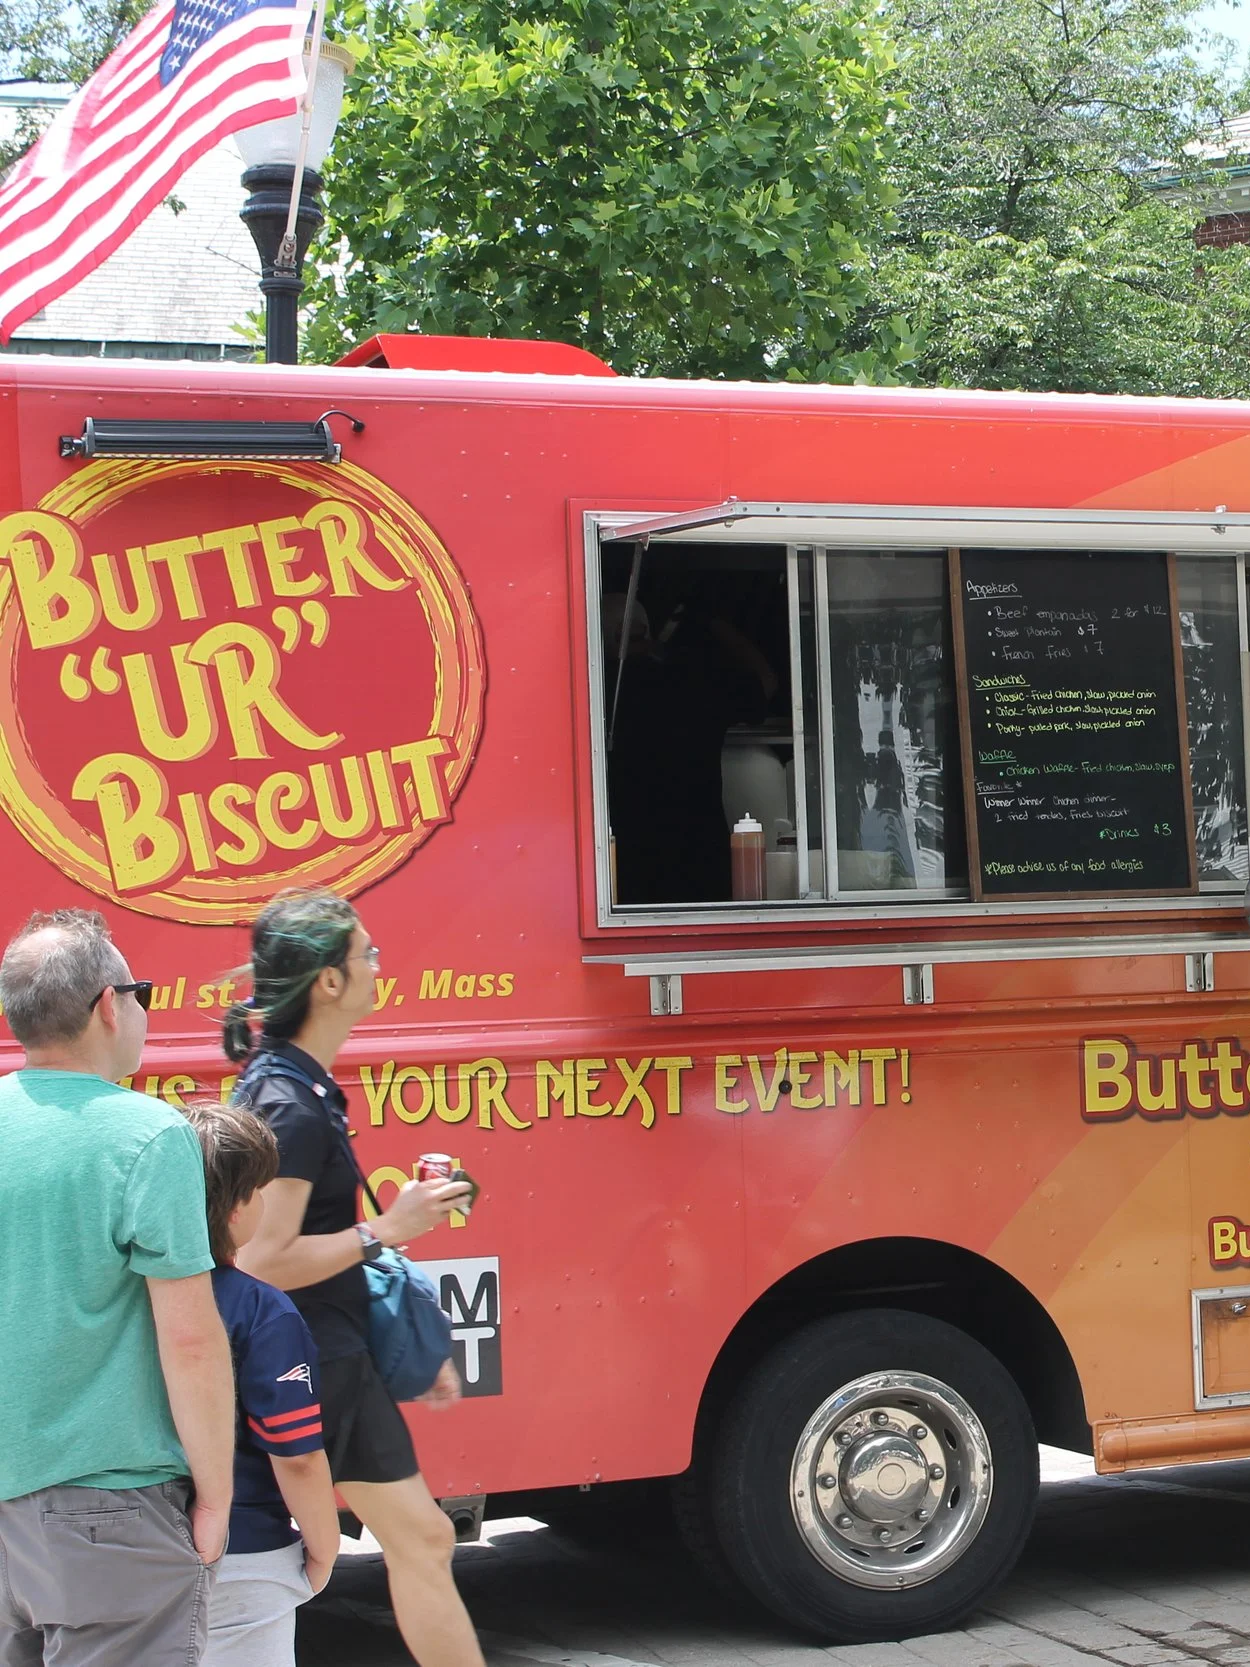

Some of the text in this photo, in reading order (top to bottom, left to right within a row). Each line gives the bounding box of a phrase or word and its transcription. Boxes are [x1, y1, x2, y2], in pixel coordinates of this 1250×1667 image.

[966, 580, 1018, 598] Appetizers
[994, 605, 1028, 619] Beef
[1111, 608, 1121, 619] 2
[972, 674, 1027, 688] Sandwiches
[72, 737, 455, 890] BISCUIT
[1045, 862, 1058, 872] us
[1059, 860, 1070, 872] of
[1088, 858, 1106, 872] food
[419, 969, 514, 1000] Mass
[359, 1057, 533, 1130] YOUR
[535, 1055, 694, 1129] NEXT
[714, 1047, 912, 1113] EVENT!
